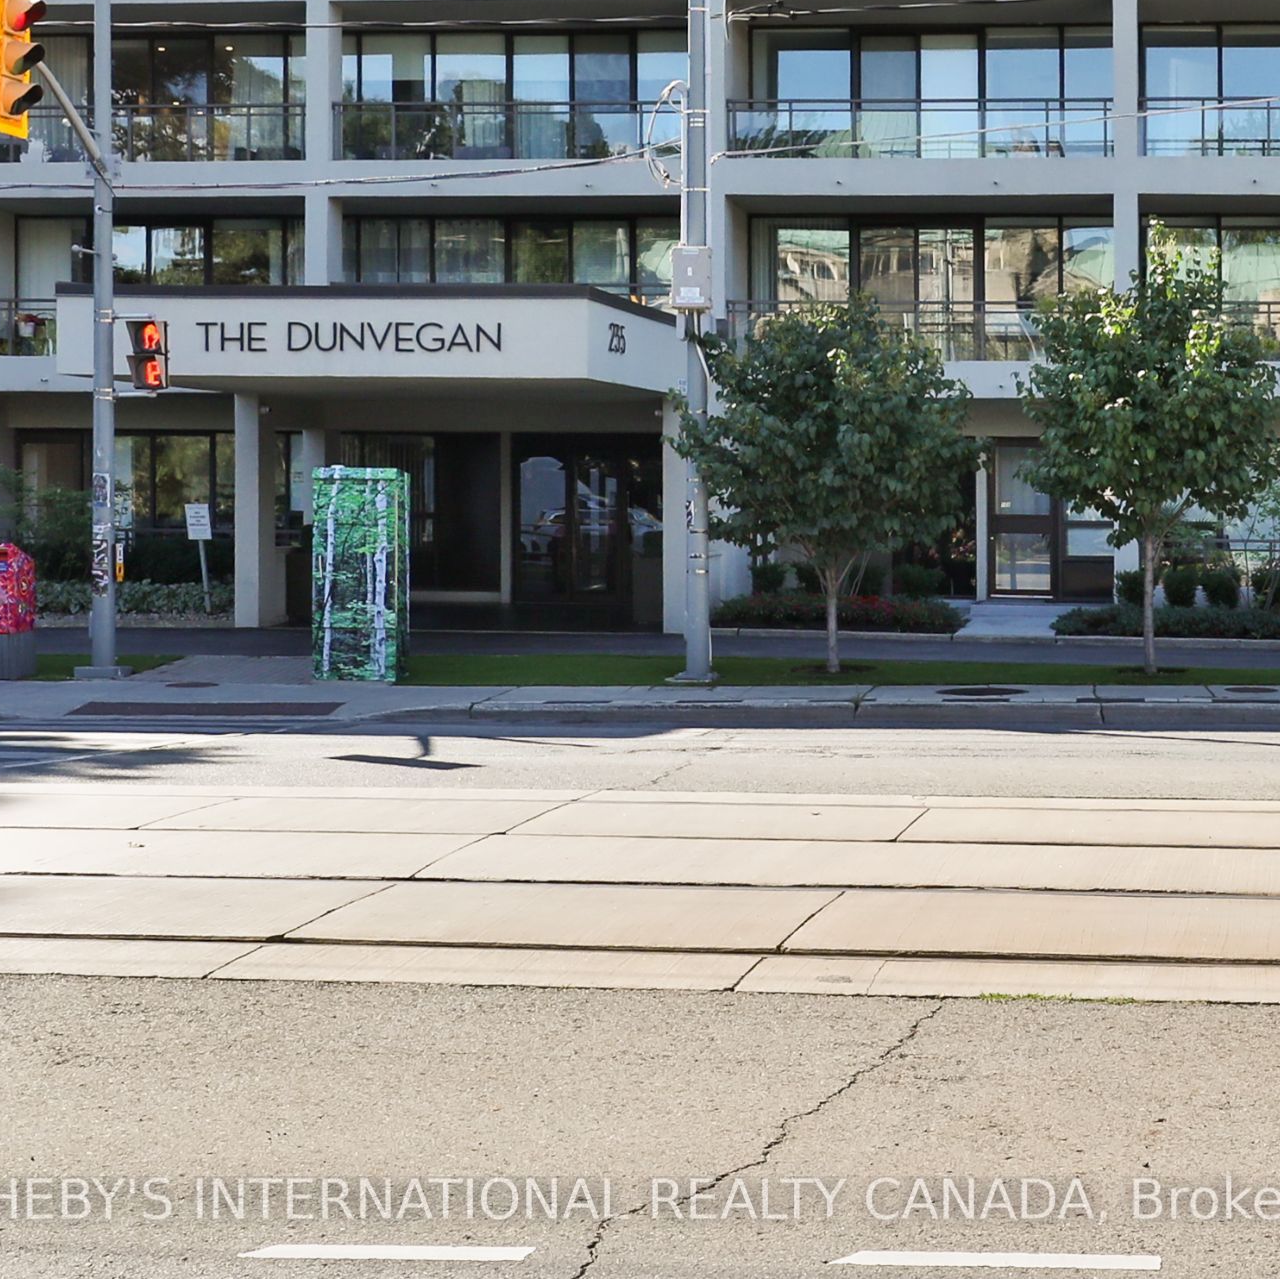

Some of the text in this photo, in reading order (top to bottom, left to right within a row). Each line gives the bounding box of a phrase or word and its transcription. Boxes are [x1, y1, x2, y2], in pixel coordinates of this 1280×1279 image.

[196, 322, 502, 352] THE DUNVEGAN
[608, 322, 627, 355] 235
